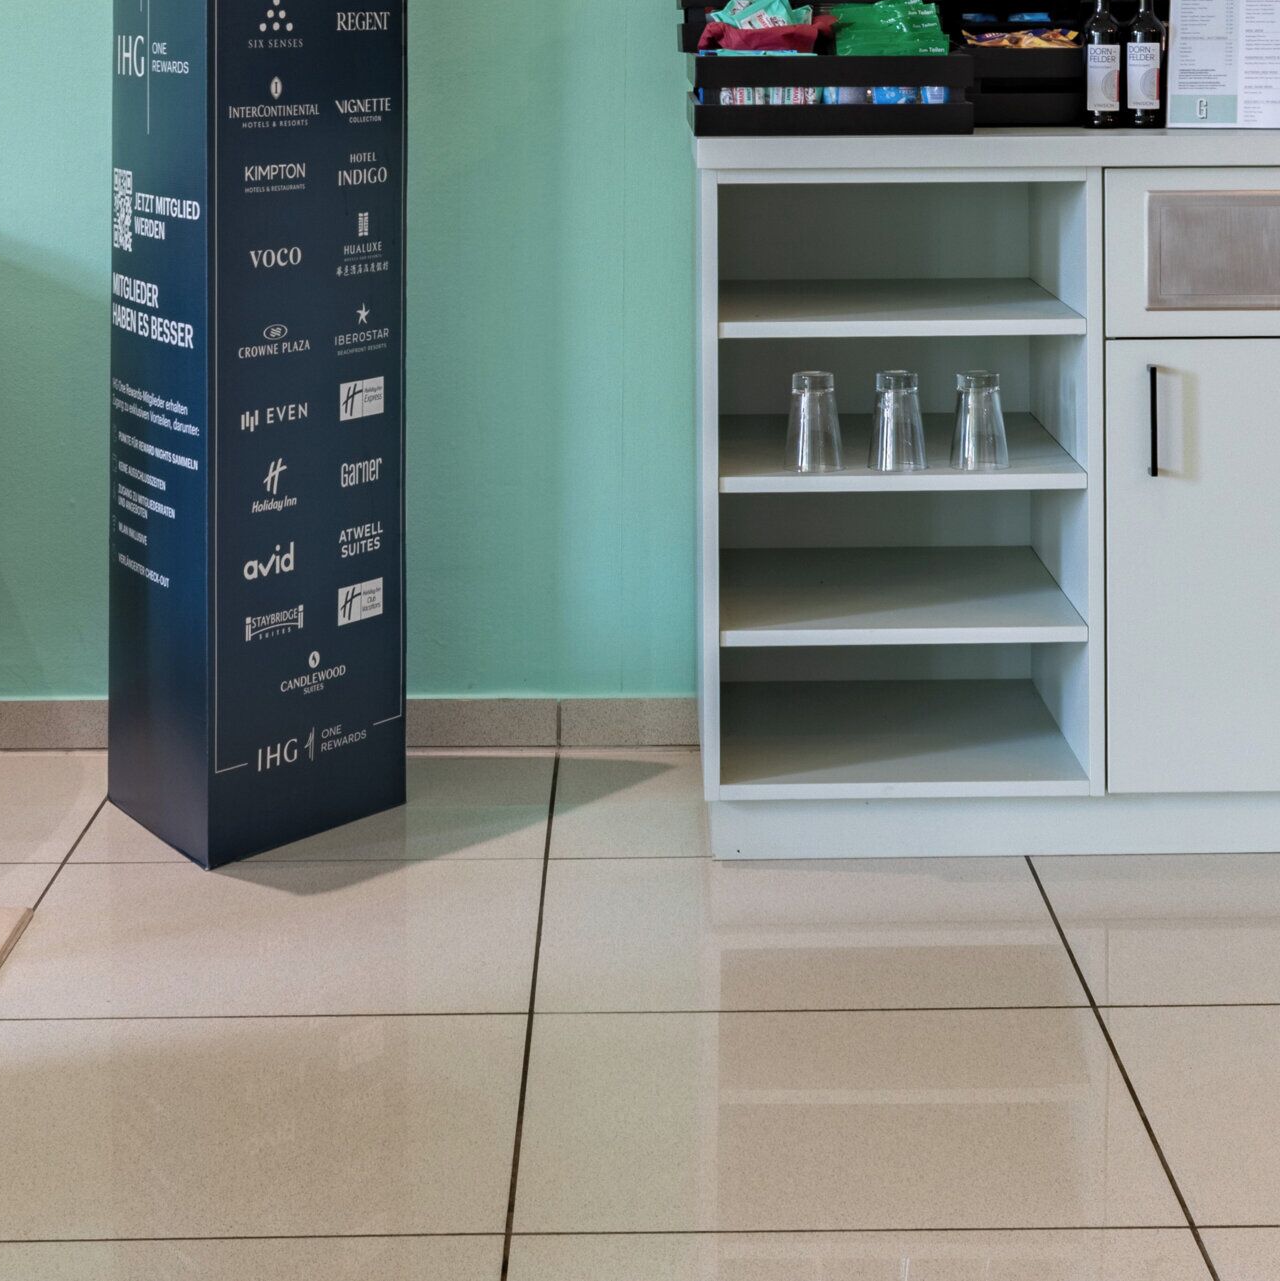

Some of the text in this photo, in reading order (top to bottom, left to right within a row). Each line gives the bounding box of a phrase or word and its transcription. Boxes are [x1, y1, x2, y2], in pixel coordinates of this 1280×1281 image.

[336, 11, 390, 31] REGENT
[152, 42, 168, 55] ONE
[247, 38, 304, 49] SIX SENSES
[117, 34, 145, 77] IHG
[1089, 55, 1117, 63] FELDER
[1128, 53, 1155, 61] FELDER
[152, 59, 189, 74] REWARDS
[335, 97, 392, 114] VIGNETTE
[242, 121, 270, 129] HOTELS
[348, 115, 382, 124] COLLECTION
[349, 152, 377, 163] HOTEL
[244, 162, 306, 182] KIMPTON
[338, 166, 388, 186] INDIGO
[244, 186, 265, 194] HOTELS
[271, 183, 306, 193] RESTAURANTS
[134, 192, 200, 221] JETZT MITGLIED
[134, 216, 166, 240] WERDEN
[343, 241, 383, 255] HUALUXE
[113, 271, 159, 309] MITGLIEDER
[112, 302, 194, 350] HABEN ES BESSER
[334, 327, 390, 346] IBEROSTAR
[238, 339, 310, 359] CROWNE PLAZA
[266, 402, 308, 424] EVEN
[340, 457, 382, 488] Garner
[252, 495, 297, 513] Holiday Inn
[338, 521, 384, 544] ATWELL
[341, 536, 381, 558] SUITES
[243, 541, 295, 581] avid
[251, 607, 298, 629] STAYBRIDGE
[259, 627, 291, 640] SUITES
[280, 665, 346, 692] CANDLEWOOD
[303, 684, 324, 695] SUITES
[321, 724, 342, 739] ONE
[321, 729, 367, 752] REWARDS
[257, 738, 298, 772] IHG
